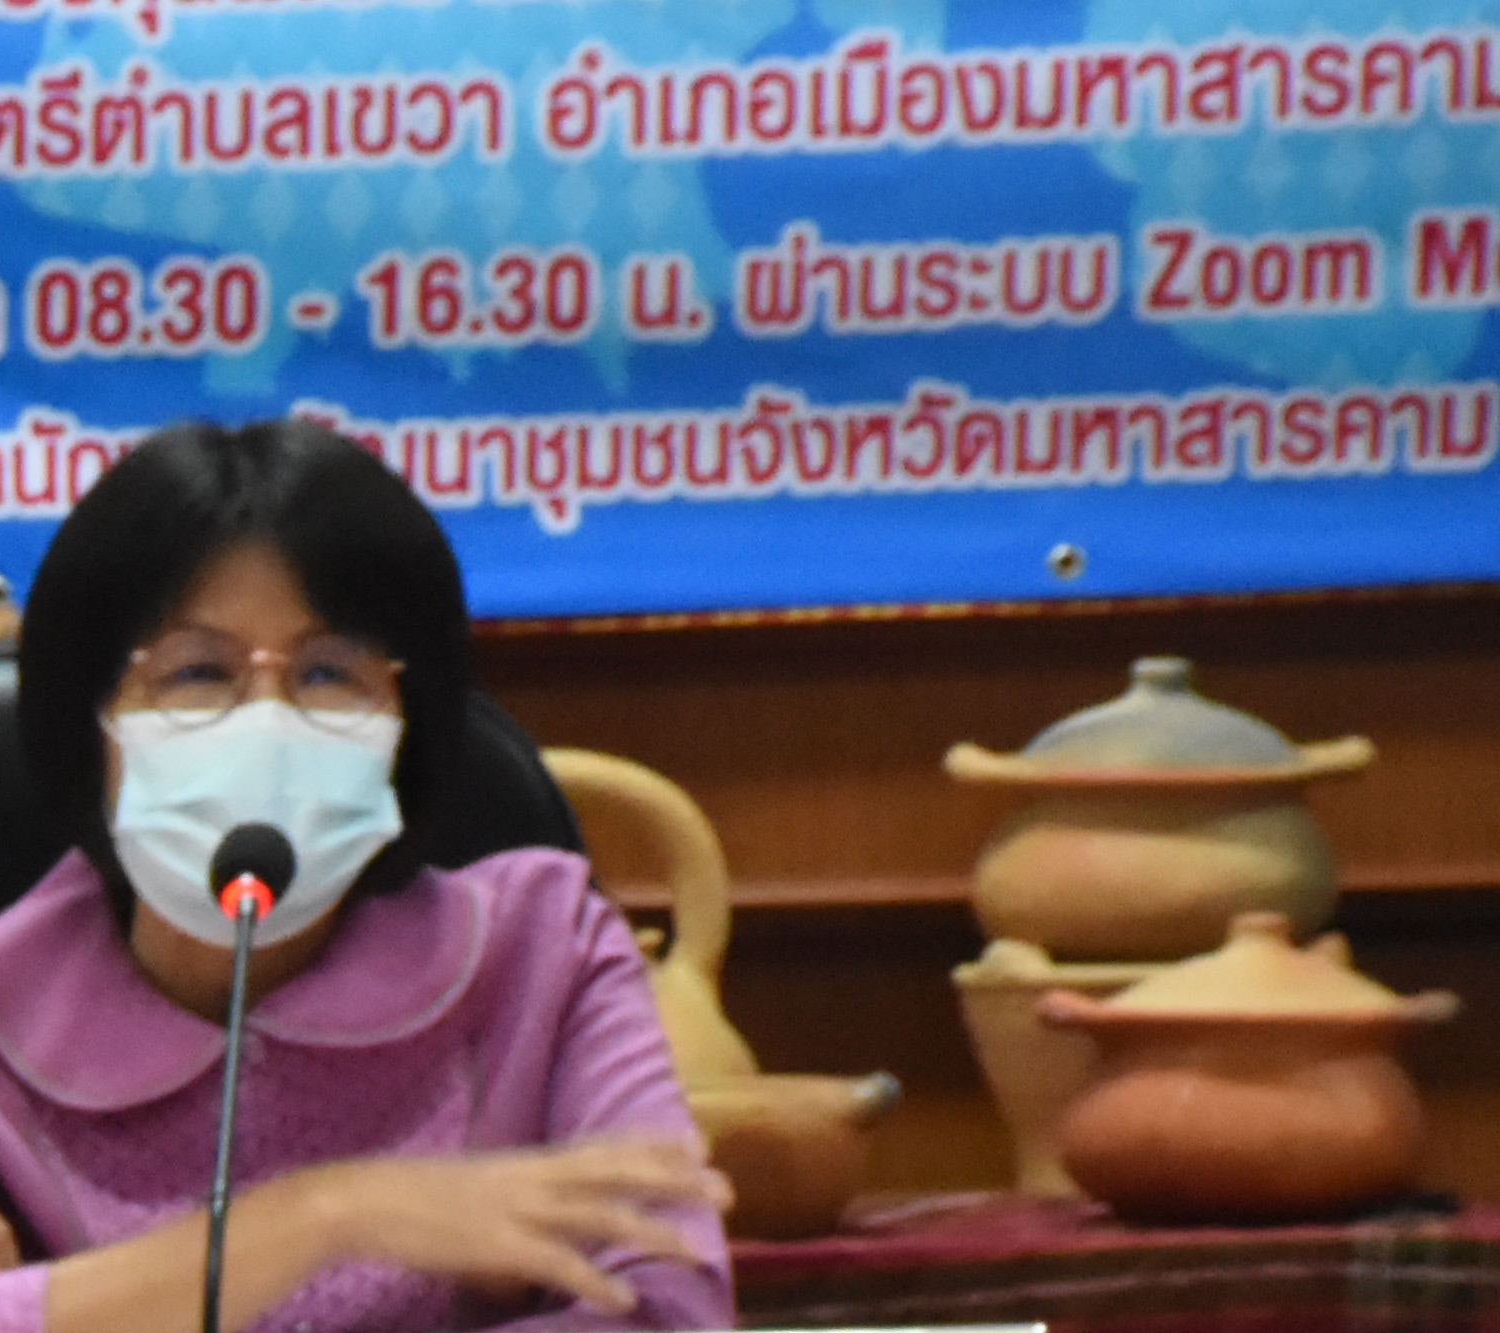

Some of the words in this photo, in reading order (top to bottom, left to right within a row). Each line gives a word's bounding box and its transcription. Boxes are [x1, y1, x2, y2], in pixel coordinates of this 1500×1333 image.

[34, 265, 258, 349] 08.30
[366, 254, 591, 336] 16.30
[744, 234, 1107, 324] ผ่านระบบ
[1148, 229, 1371, 310] Zoom
[1417, 215, 1500, 297] M
